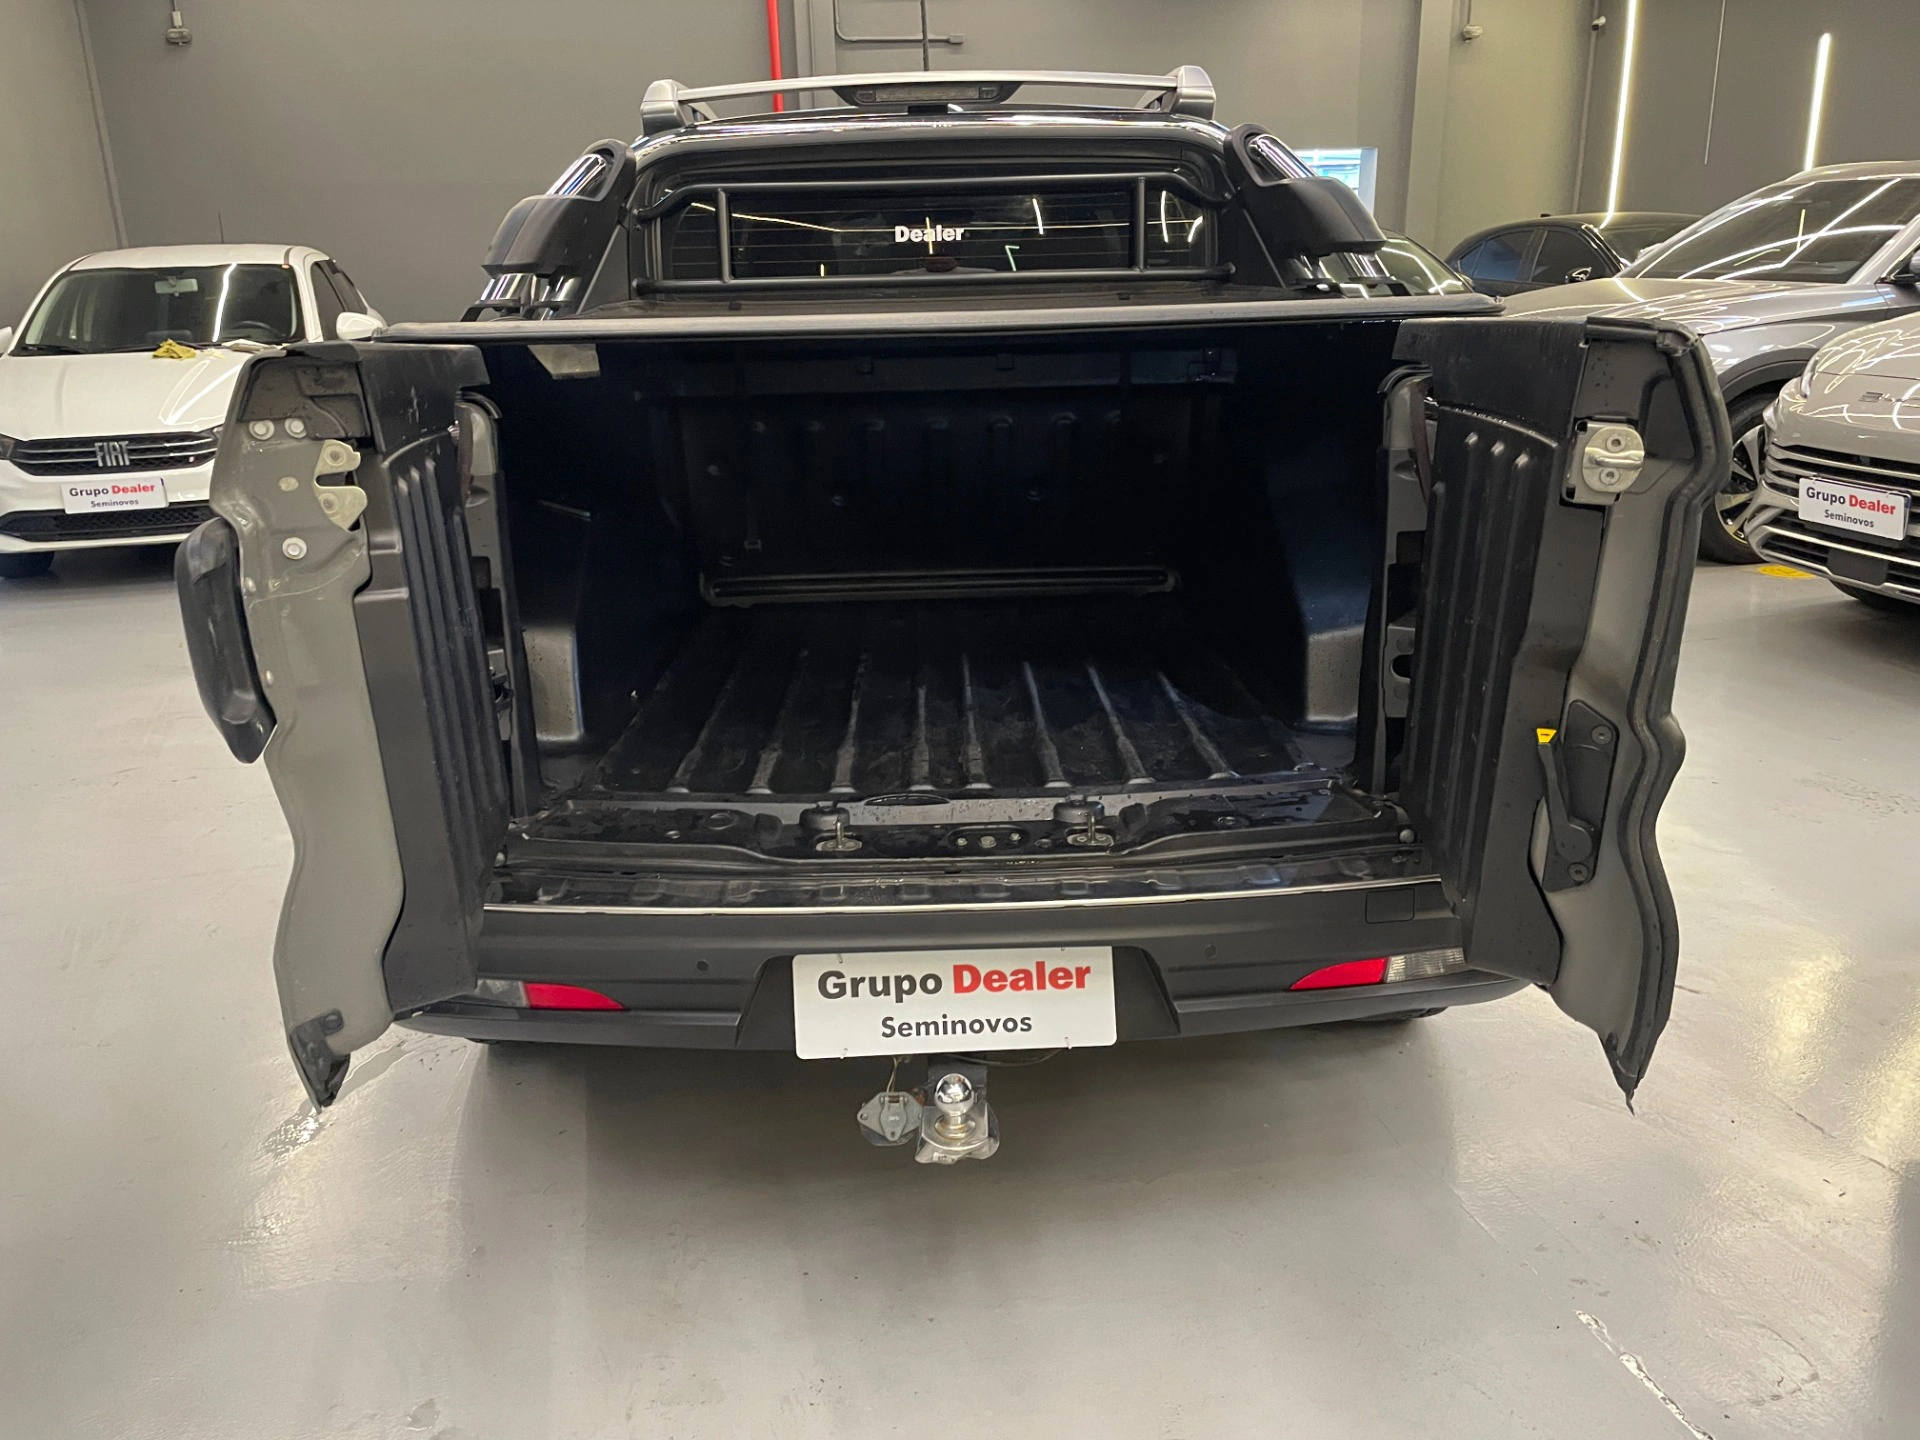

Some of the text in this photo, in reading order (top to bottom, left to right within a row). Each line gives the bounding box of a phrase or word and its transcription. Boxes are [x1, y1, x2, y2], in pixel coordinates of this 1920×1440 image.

[894, 224, 965, 243] Dealer
[94, 441, 130, 467] FIAT
[69, 484, 155, 497] Grupo Dealer
[1806, 486, 1896, 515] Grupo Dealer
[91, 499, 139, 508] Seminovos
[1824, 509, 1874, 528] Seminovos
[818, 961, 1091, 1003] Grupo Dealer
[881, 1013, 1033, 1038] Seminovos
